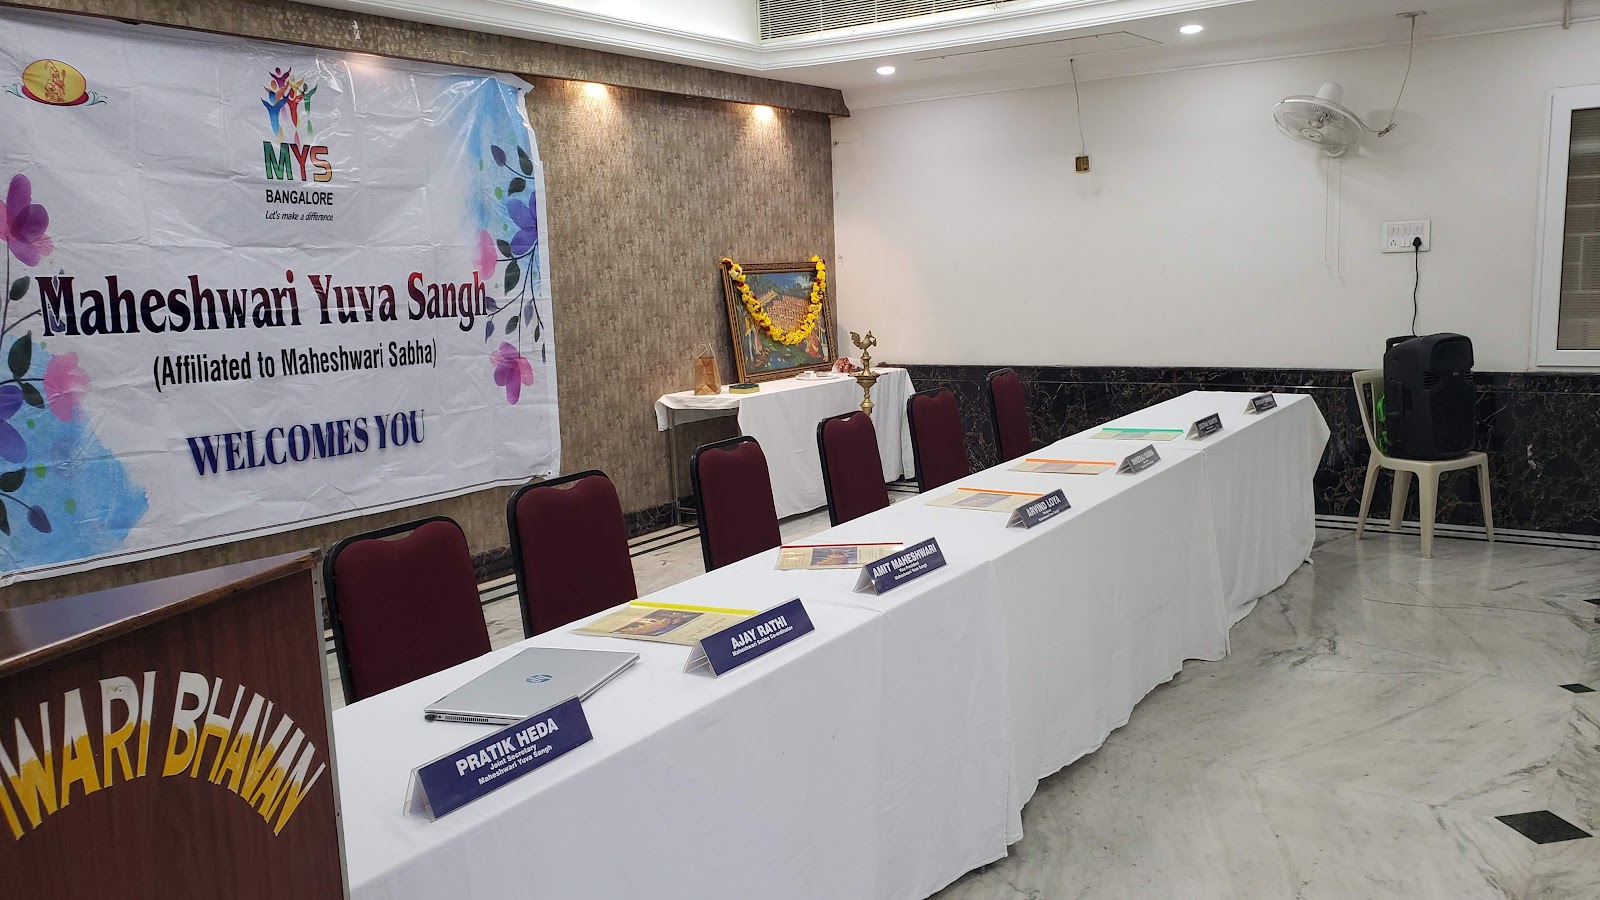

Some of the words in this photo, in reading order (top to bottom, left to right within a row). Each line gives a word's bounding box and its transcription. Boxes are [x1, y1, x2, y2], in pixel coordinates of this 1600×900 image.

[263, 141, 333, 182] MYS
[265, 210, 280, 220] Let's
[281, 212, 299, 221] make
[305, 211, 334, 221] difference
[266, 189, 333, 205] BANGALORE
[35, 269, 302, 337] Maheshwari
[308, 274, 398, 325] Yuva
[407, 271, 488, 331] Sangh
[153, 351, 252, 393] (Affiliated
[257, 351, 275, 378] to
[281, 343, 384, 376] Maheshwari
[388, 338, 437, 369] Sabha)
[185, 416, 370, 476] WELCOMES
[374, 409, 425, 450] YOU
[1025, 501, 1048, 518] ARVIND
[1045, 494, 1062, 508] LOYA
[872, 562, 892, 579] AMIT
[890, 543, 938, 570] MAHESHWARI
[730, 628, 757, 650] AJAY
[756, 615, 788, 637] RATHI
[731, 641, 758, 657] Maheshwari
[757, 635, 771, 646] Sabha
[162, 671, 327, 837] BHAVAN
[455, 736, 517, 777] PRATIK
[515, 717, 560, 747] HEDA
[478, 762, 518, 785] Maheshwari
[517, 755, 533, 766] Yuva
[533, 744, 553, 758] Sangh
[489, 758, 507, 771] Joint
[506, 744, 537, 761] Secretary
